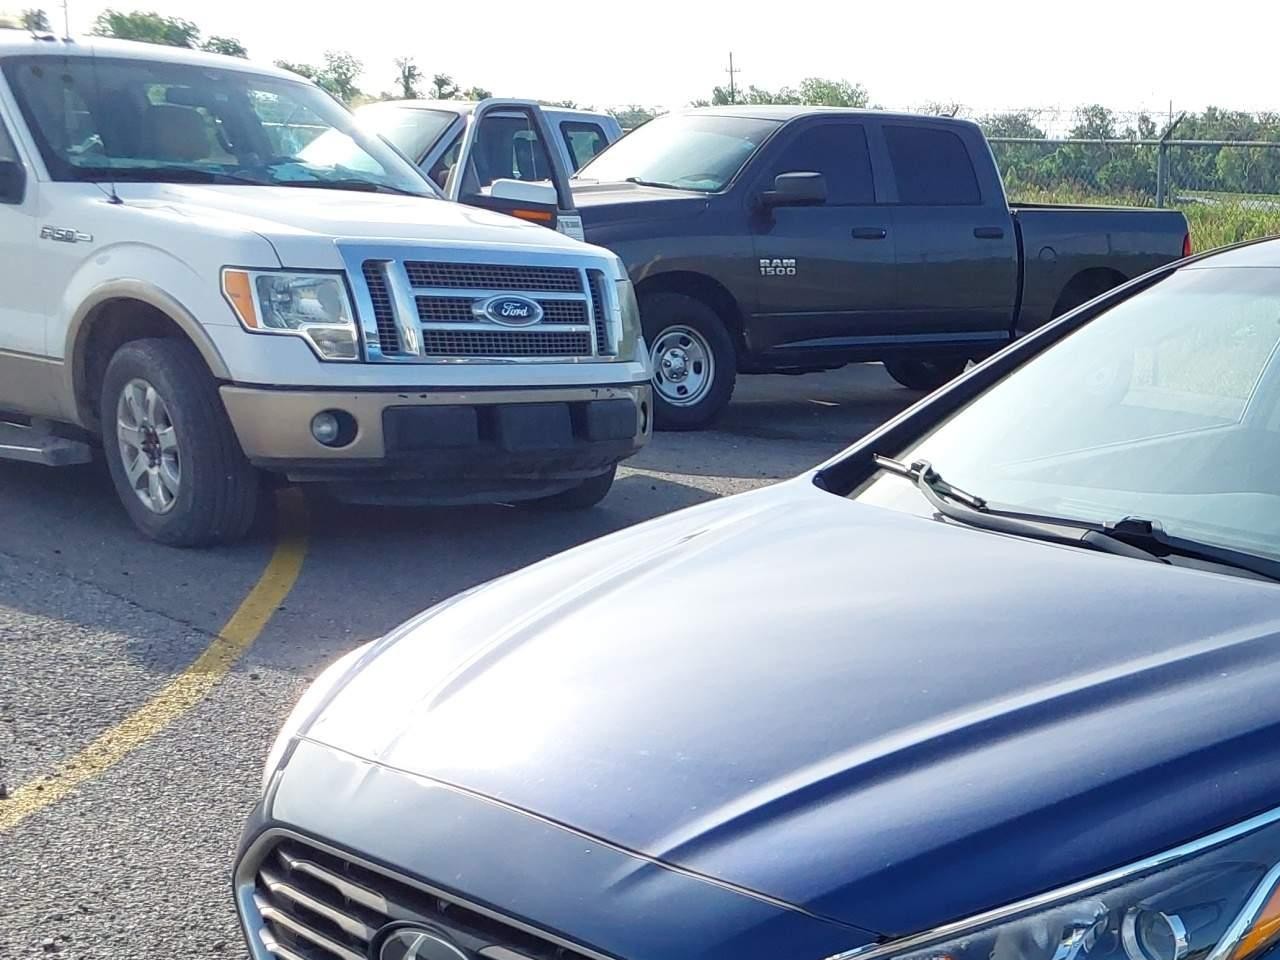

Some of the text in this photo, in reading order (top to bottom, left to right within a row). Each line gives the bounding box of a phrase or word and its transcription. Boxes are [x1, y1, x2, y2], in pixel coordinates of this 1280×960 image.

[760, 258, 796, 267] RAM
[760, 267, 796, 276] 1500
[501, 302, 528, 316] Ford
